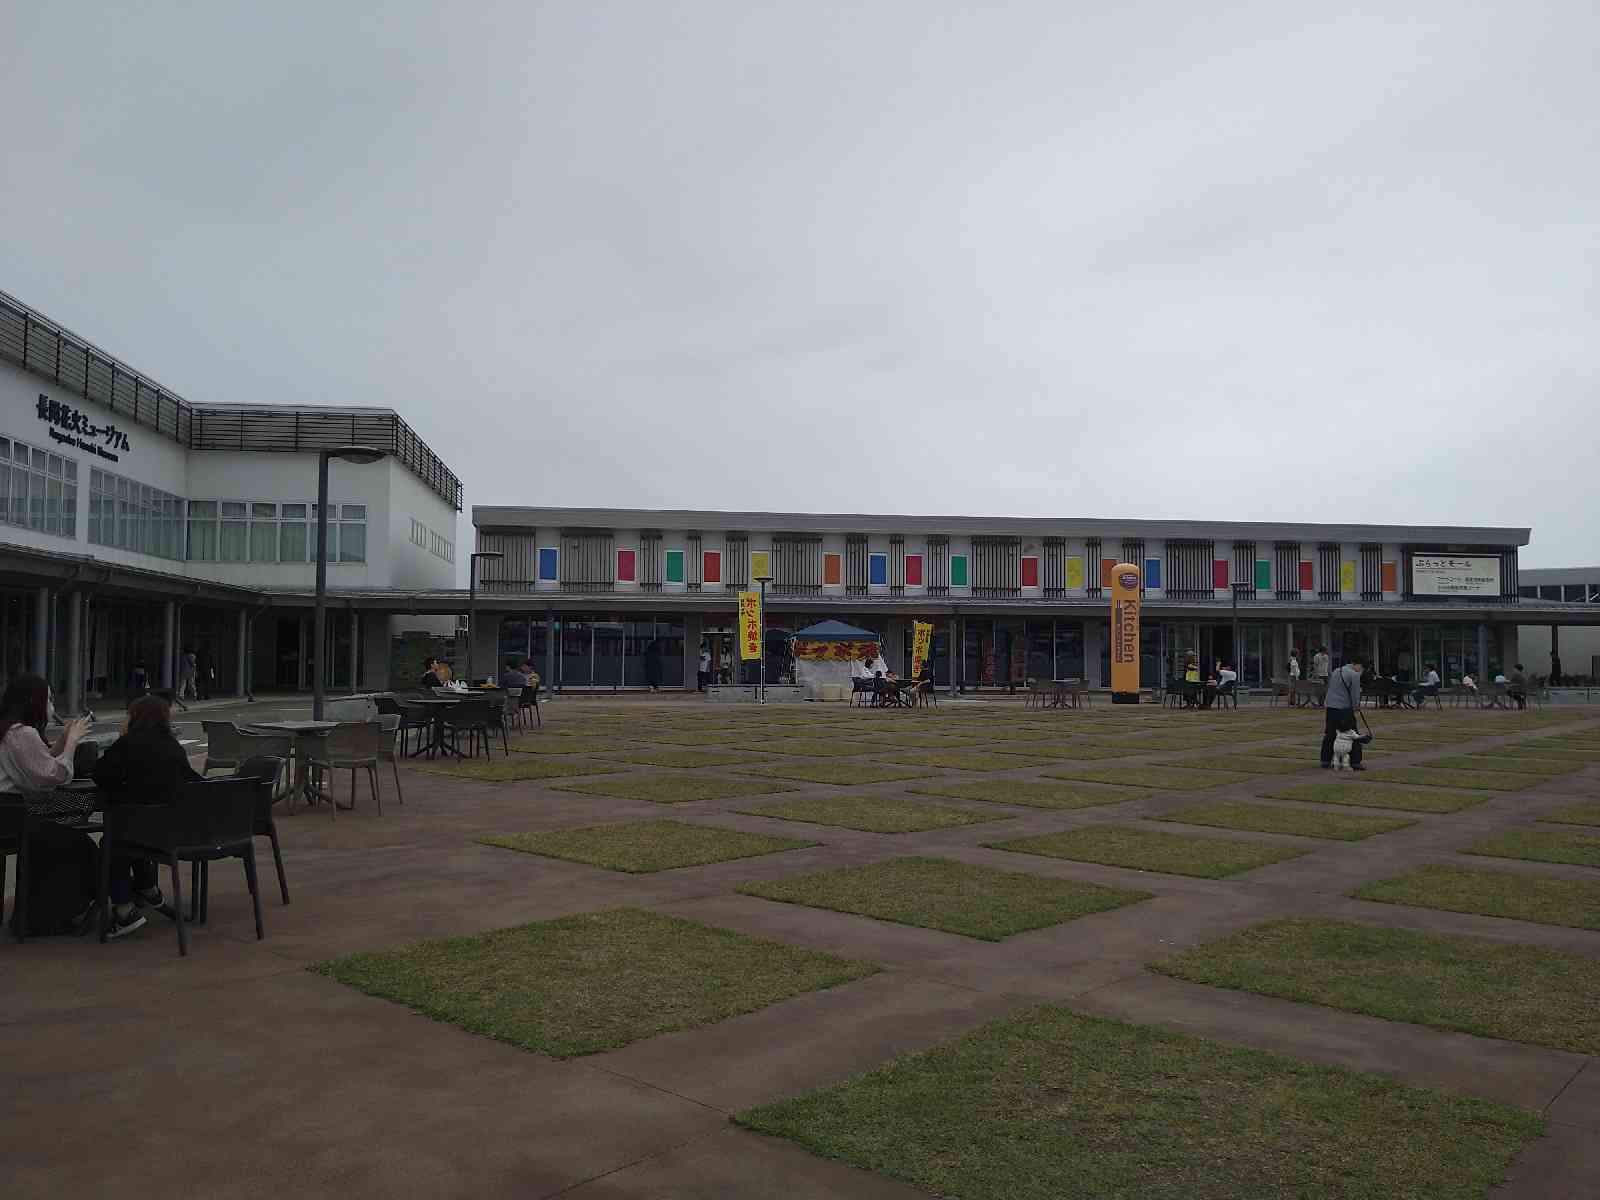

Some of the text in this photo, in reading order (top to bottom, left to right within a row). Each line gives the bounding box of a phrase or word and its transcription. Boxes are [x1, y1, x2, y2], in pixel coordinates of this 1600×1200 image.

[36, 393, 130, 451] 長岡花火ミュージアム
[1123, 599, 1137, 664] Kitchen
